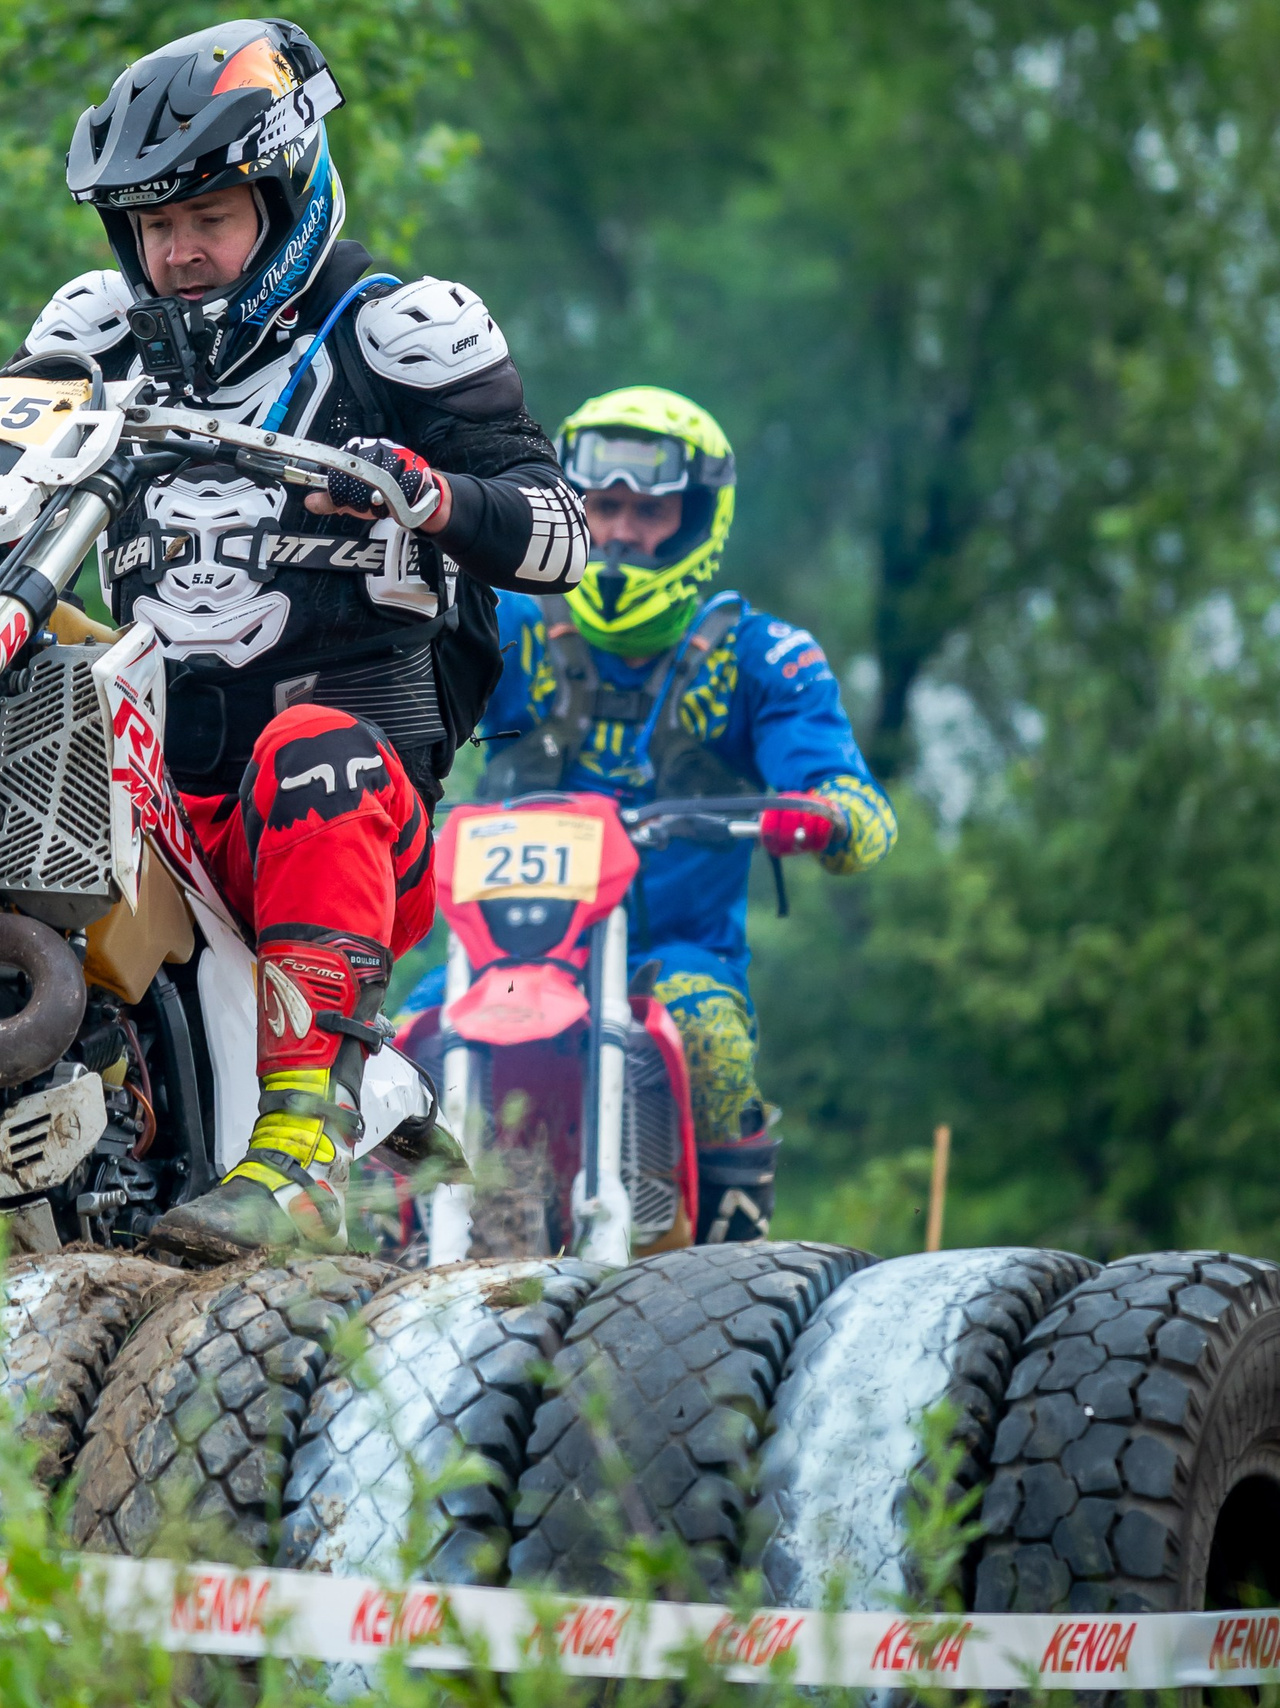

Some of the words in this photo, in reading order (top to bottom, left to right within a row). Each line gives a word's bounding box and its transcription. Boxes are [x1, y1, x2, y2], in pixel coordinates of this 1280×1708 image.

[452, 334, 479, 355] LEATT
[191, 573, 215, 585] 5.5
[484, 844, 571, 885] 251
[350, 955, 381, 967] BOULDER
[1039, 1622, 1138, 1674] KENDA
[1208, 1616, 1280, 1670] KEND
